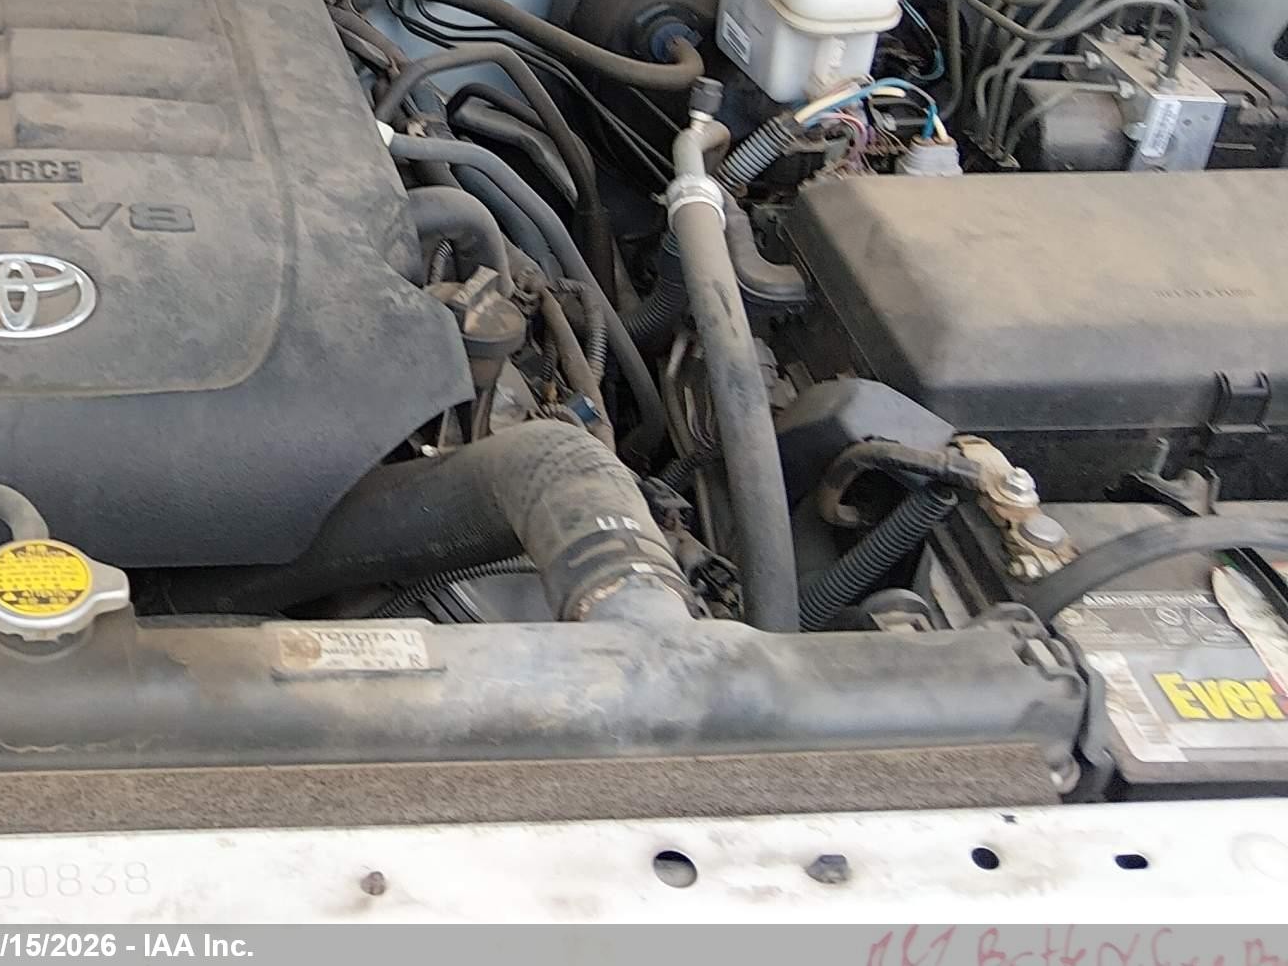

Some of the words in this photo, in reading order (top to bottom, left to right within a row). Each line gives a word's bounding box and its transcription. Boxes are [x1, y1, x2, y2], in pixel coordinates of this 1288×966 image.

[53, 200, 196, 233] V8
[314, 630, 397, 642] TOYOTA
[1153, 672, 1287, 721] Ever
